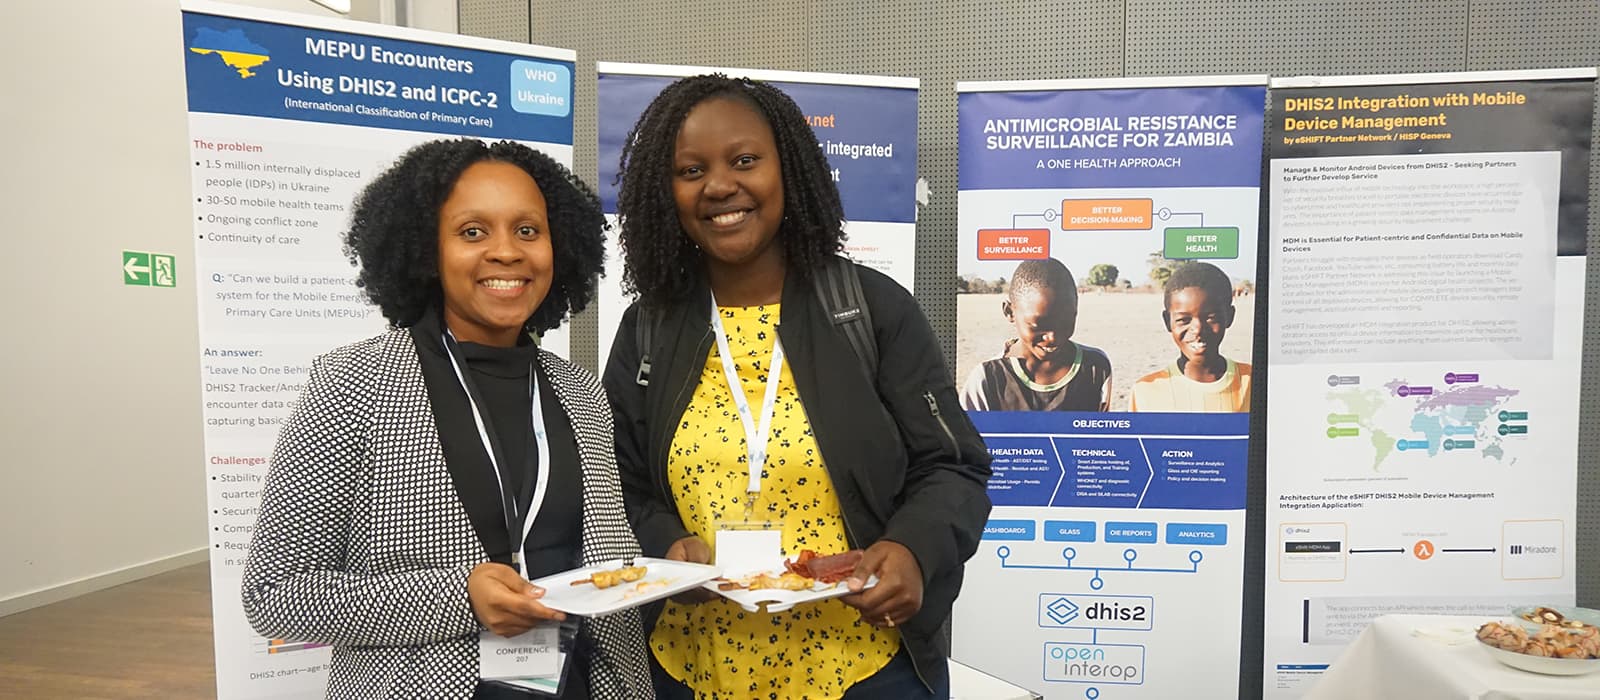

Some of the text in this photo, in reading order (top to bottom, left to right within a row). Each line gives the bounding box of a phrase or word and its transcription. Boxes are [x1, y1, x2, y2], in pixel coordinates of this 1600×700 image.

[305, 37, 473, 73] MEPU Encounters
[525, 68, 556, 82] WHO
[278, 68, 498, 108] Using DHIS2 and ICPC-2
[517, 90, 564, 106] Ukraine
[1284, 92, 1526, 111] DHIS2 Integration with Mobile
[284, 98, 493, 128] (International Classification of Primary Care)
[984, 115, 1237, 133] ANTIMICROBIAL RESISTANCE
[1284, 113, 1446, 131] Device Management
[986, 132, 1233, 150] SURVEILLANCE FOR ZAMBIA
[1284, 132, 1451, 145] by eSHIFT Partner Network HISP Geneva
[194, 140, 263, 153] The problem
[827, 141, 892, 159] integrated
[206, 160, 360, 178] 1.5 million internally displaced
[1036, 158, 1180, 169] A ONE HEALTH APPROACH
[206, 178, 330, 193] people (IDPs) in Ukraine
[207, 196, 344, 211] 30-50 mobile health teams
[208, 214, 251, 226] Ongoing
[255, 216, 291, 227] conflict
[1071, 216, 1144, 224] DECISION-MAKING
[208, 233, 262, 244] Continuity
[265, 235, 275, 243] of
[1186, 235, 1218, 243] BETTER
[212, 273, 224, 283] Q:
[256, 275, 270, 283] we
[274, 274, 299, 284] build
[302, 277, 307, 285] a
[216, 292, 252, 301] system
[256, 291, 269, 300] for
[273, 292, 289, 301] the
[293, 292, 327, 301] Mobile
[226, 308, 265, 318] Primary
[269, 309, 292, 318] Care
[295, 309, 321, 318] Units
[204, 348, 218, 357] An
[242, 366, 256, 375] No
[260, 366, 280, 375] One
[206, 383, 235, 392] DHIS2
[207, 401, 257, 409] encounter
[262, 400, 284, 409] data
[207, 416, 254, 427] capturing
[1072, 420, 1130, 429] OBJECTIVES
[992, 448, 1022, 456] HEALTH
[211, 456, 265, 466] Challenges
[221, 474, 261, 483] Stability
[1085, 602, 1145, 621] dhis2
[496, 647, 549, 655] CONFERENCE
[1051, 648, 1104, 662] open
[250, 671, 274, 680] DHIS2
[1064, 661, 1137, 680] interop
